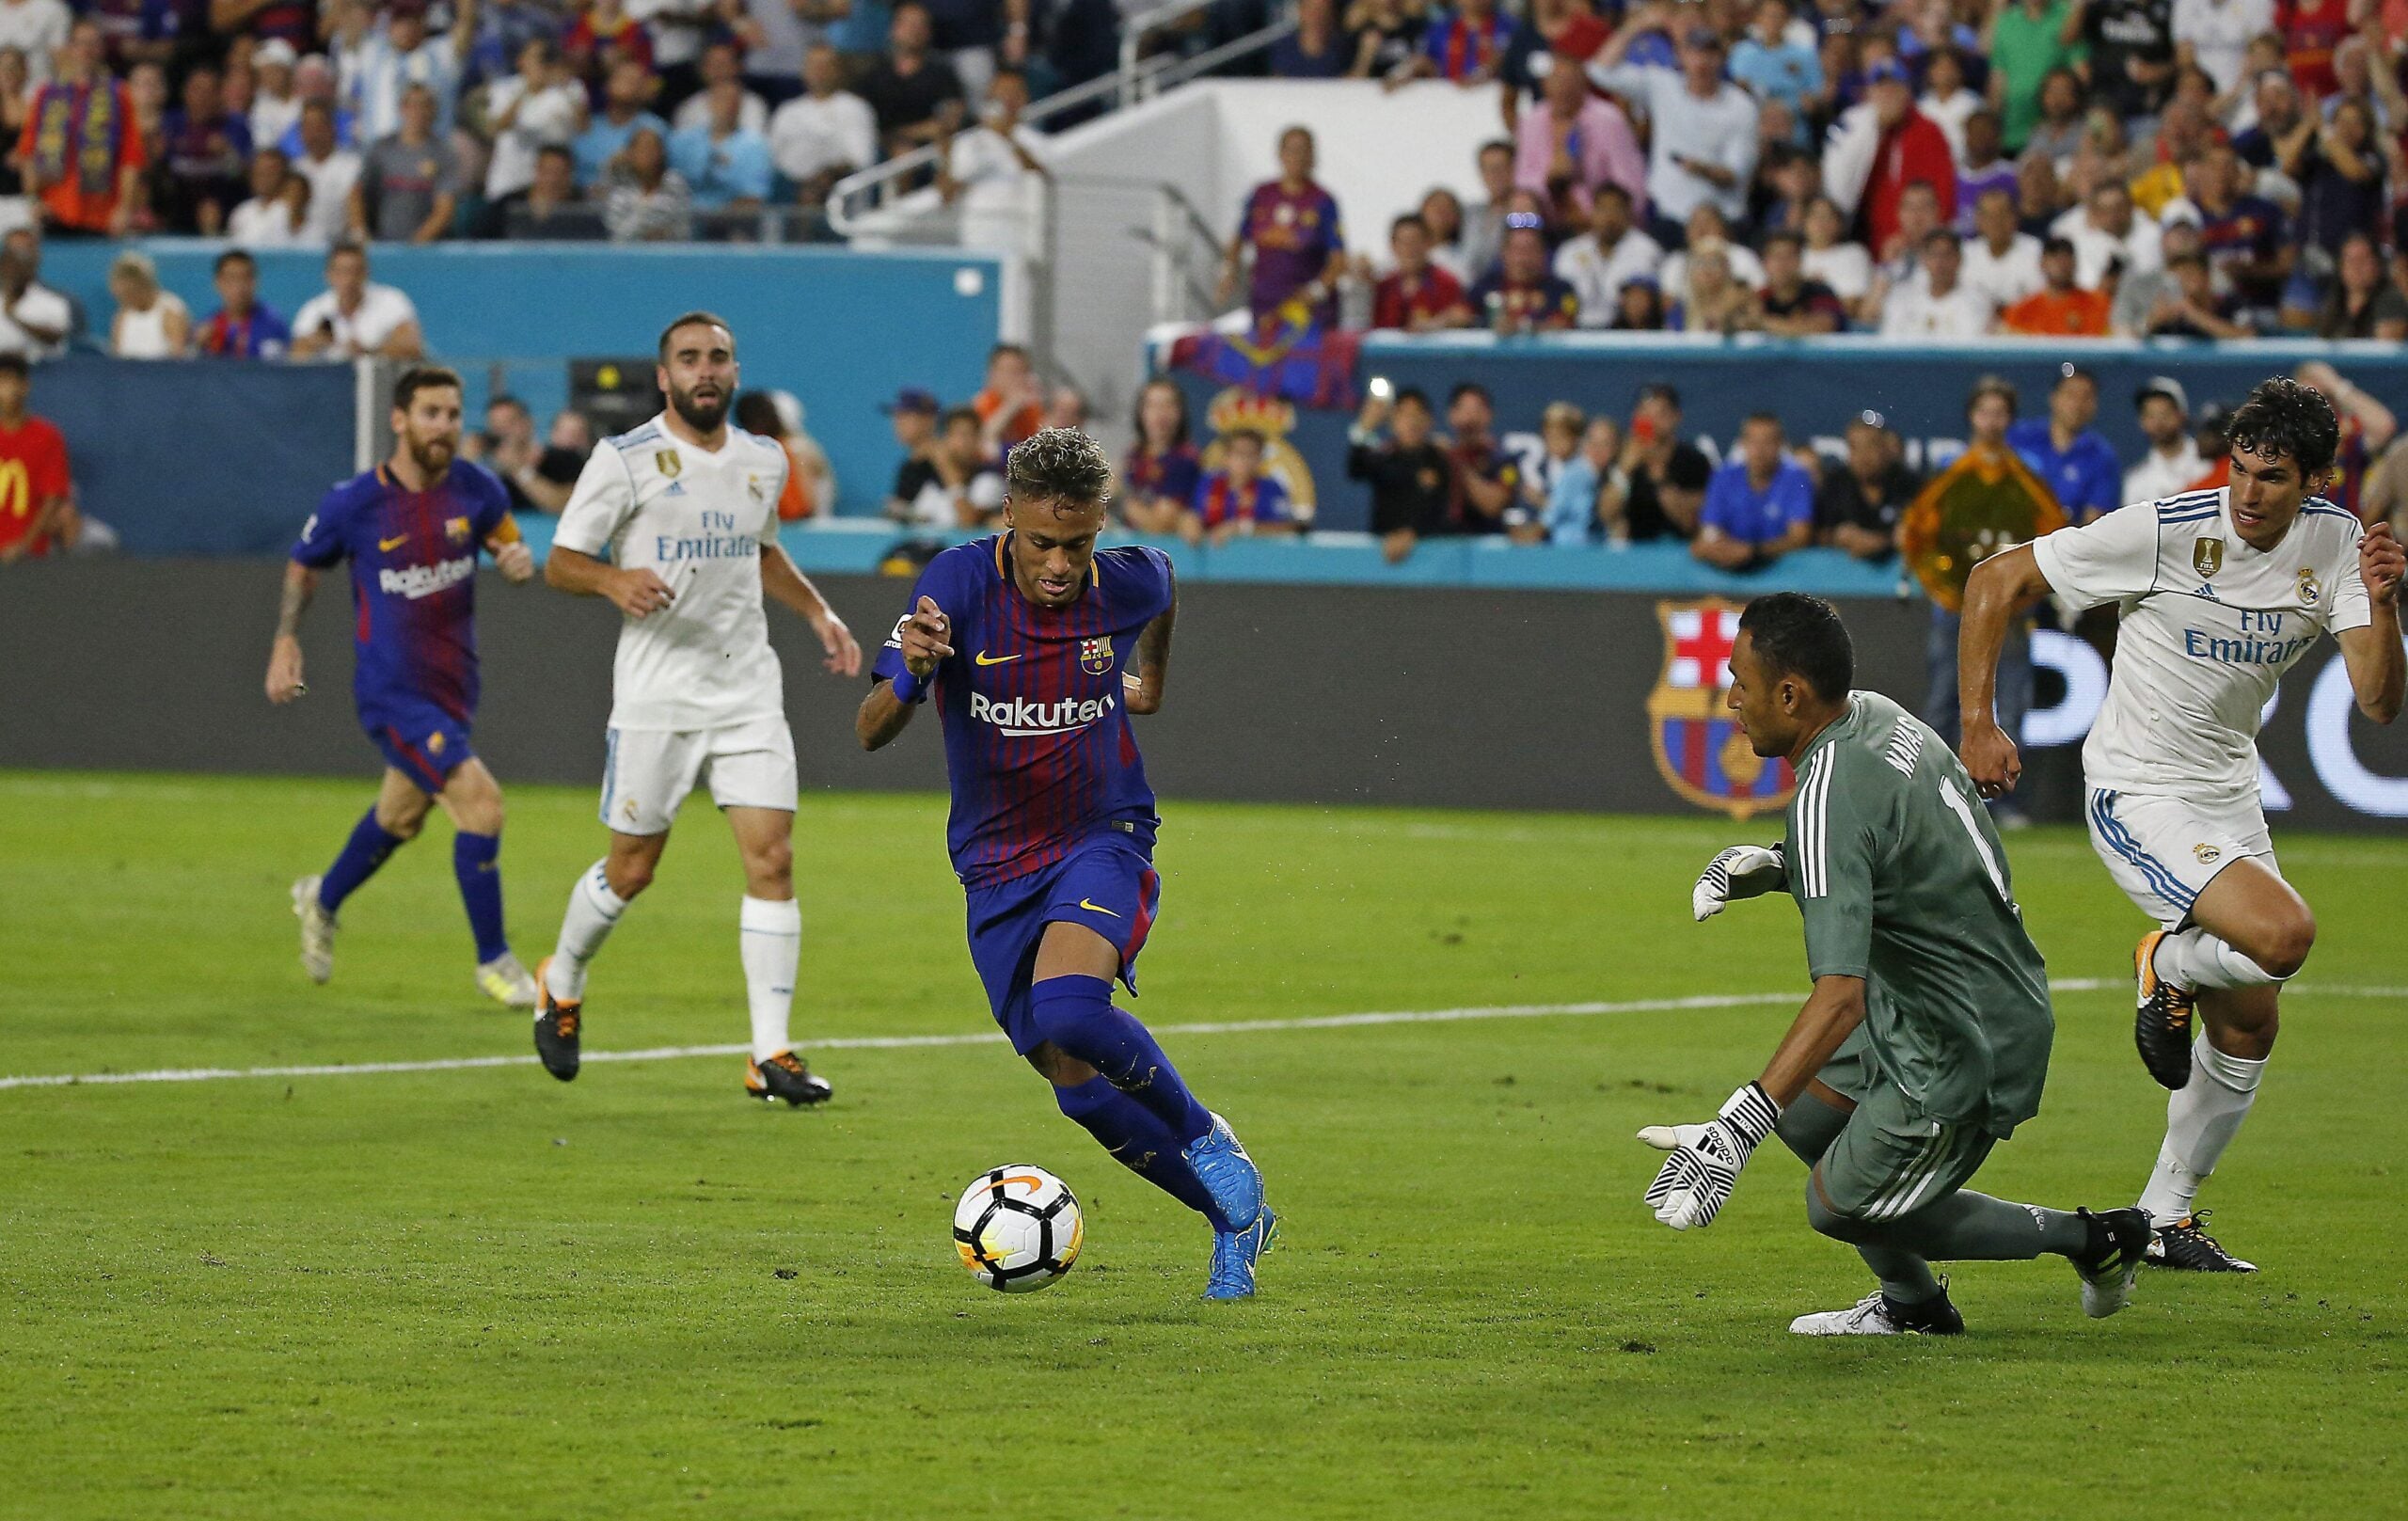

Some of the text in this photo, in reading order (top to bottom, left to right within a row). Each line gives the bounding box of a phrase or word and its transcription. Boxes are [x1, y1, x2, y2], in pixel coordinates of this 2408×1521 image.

[702, 510, 735, 531] Fly
[656, 531, 757, 562] Emirate
[2241, 609, 2282, 636] Fly
[2183, 634, 2314, 664] Emirate
[970, 691, 1116, 728] Rakuten
[1884, 715, 1925, 780] NAVAS
[1939, 774, 2009, 903] 1
[1705, 1126, 1735, 1165] adidas
